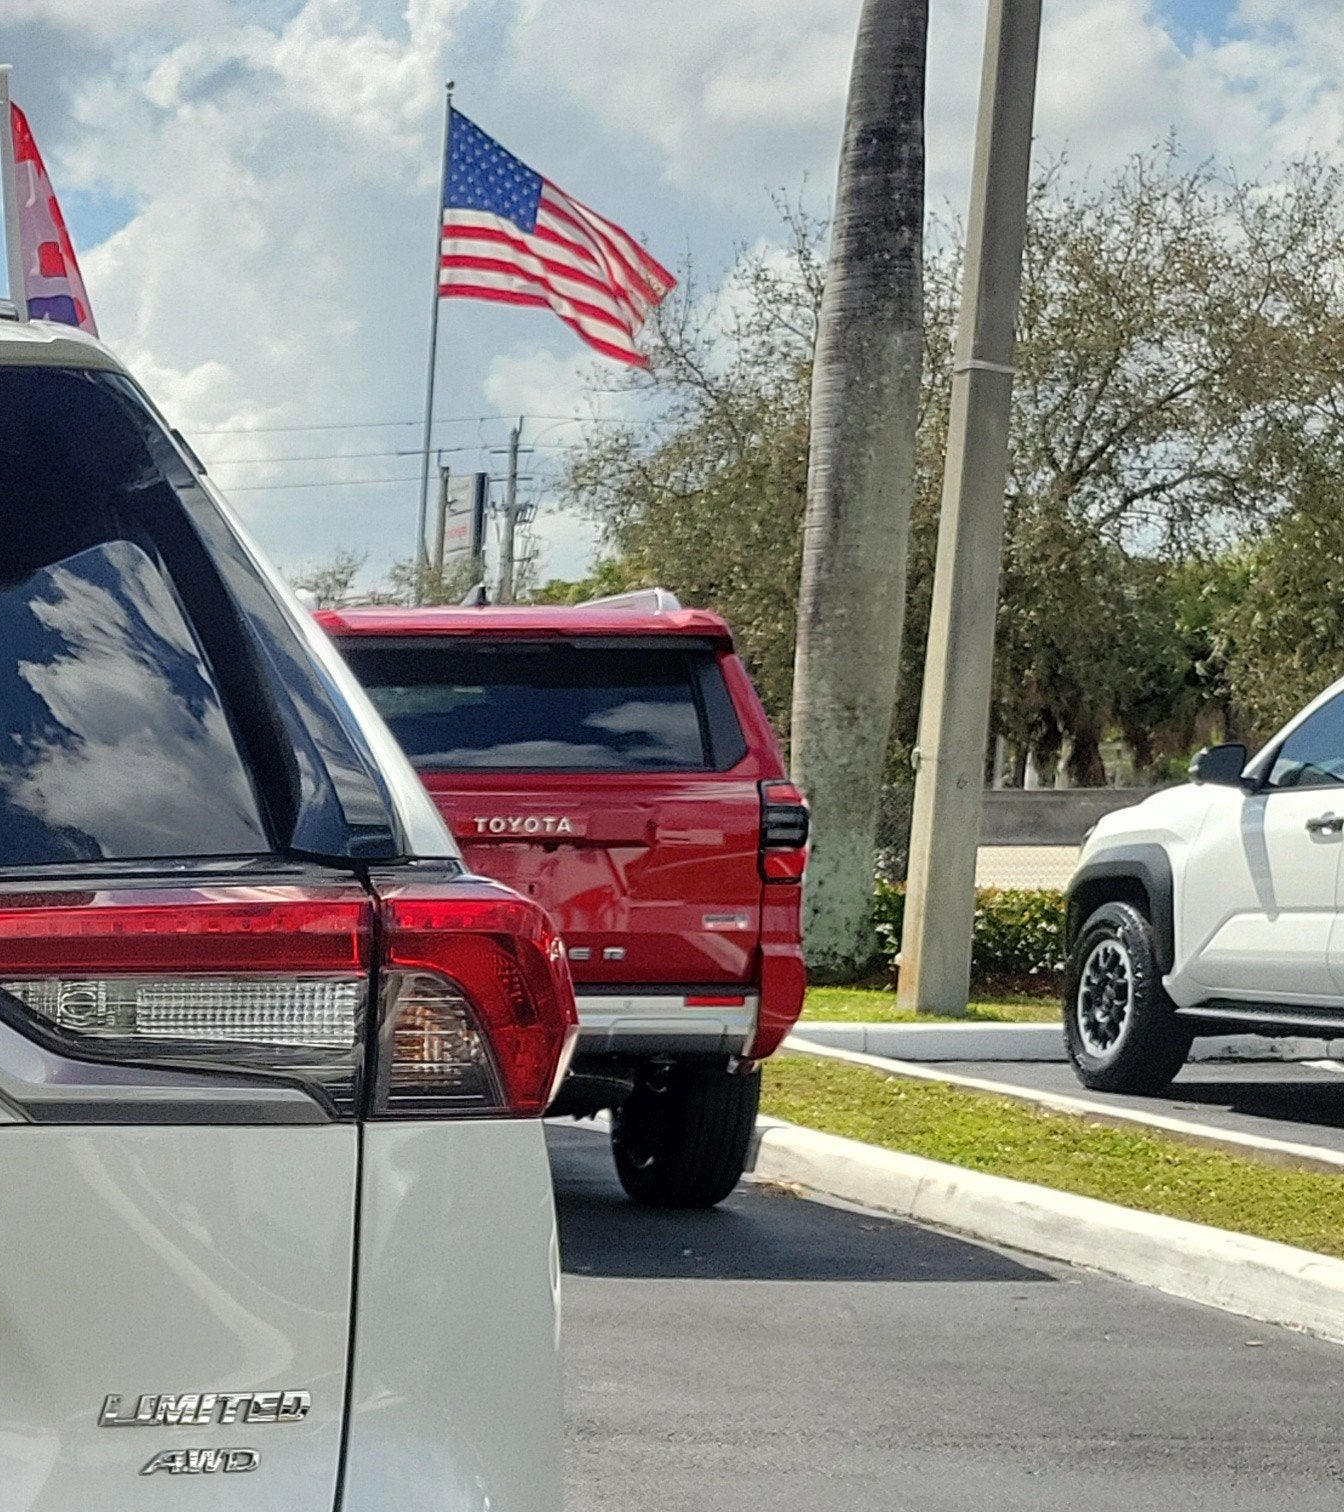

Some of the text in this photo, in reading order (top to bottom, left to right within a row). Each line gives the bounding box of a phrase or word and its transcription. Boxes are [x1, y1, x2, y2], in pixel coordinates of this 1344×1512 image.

[473, 815, 573, 834] TOYOTA
[96, 1388, 311, 1428] LIMITED
[138, 1446, 261, 1476] AWD
